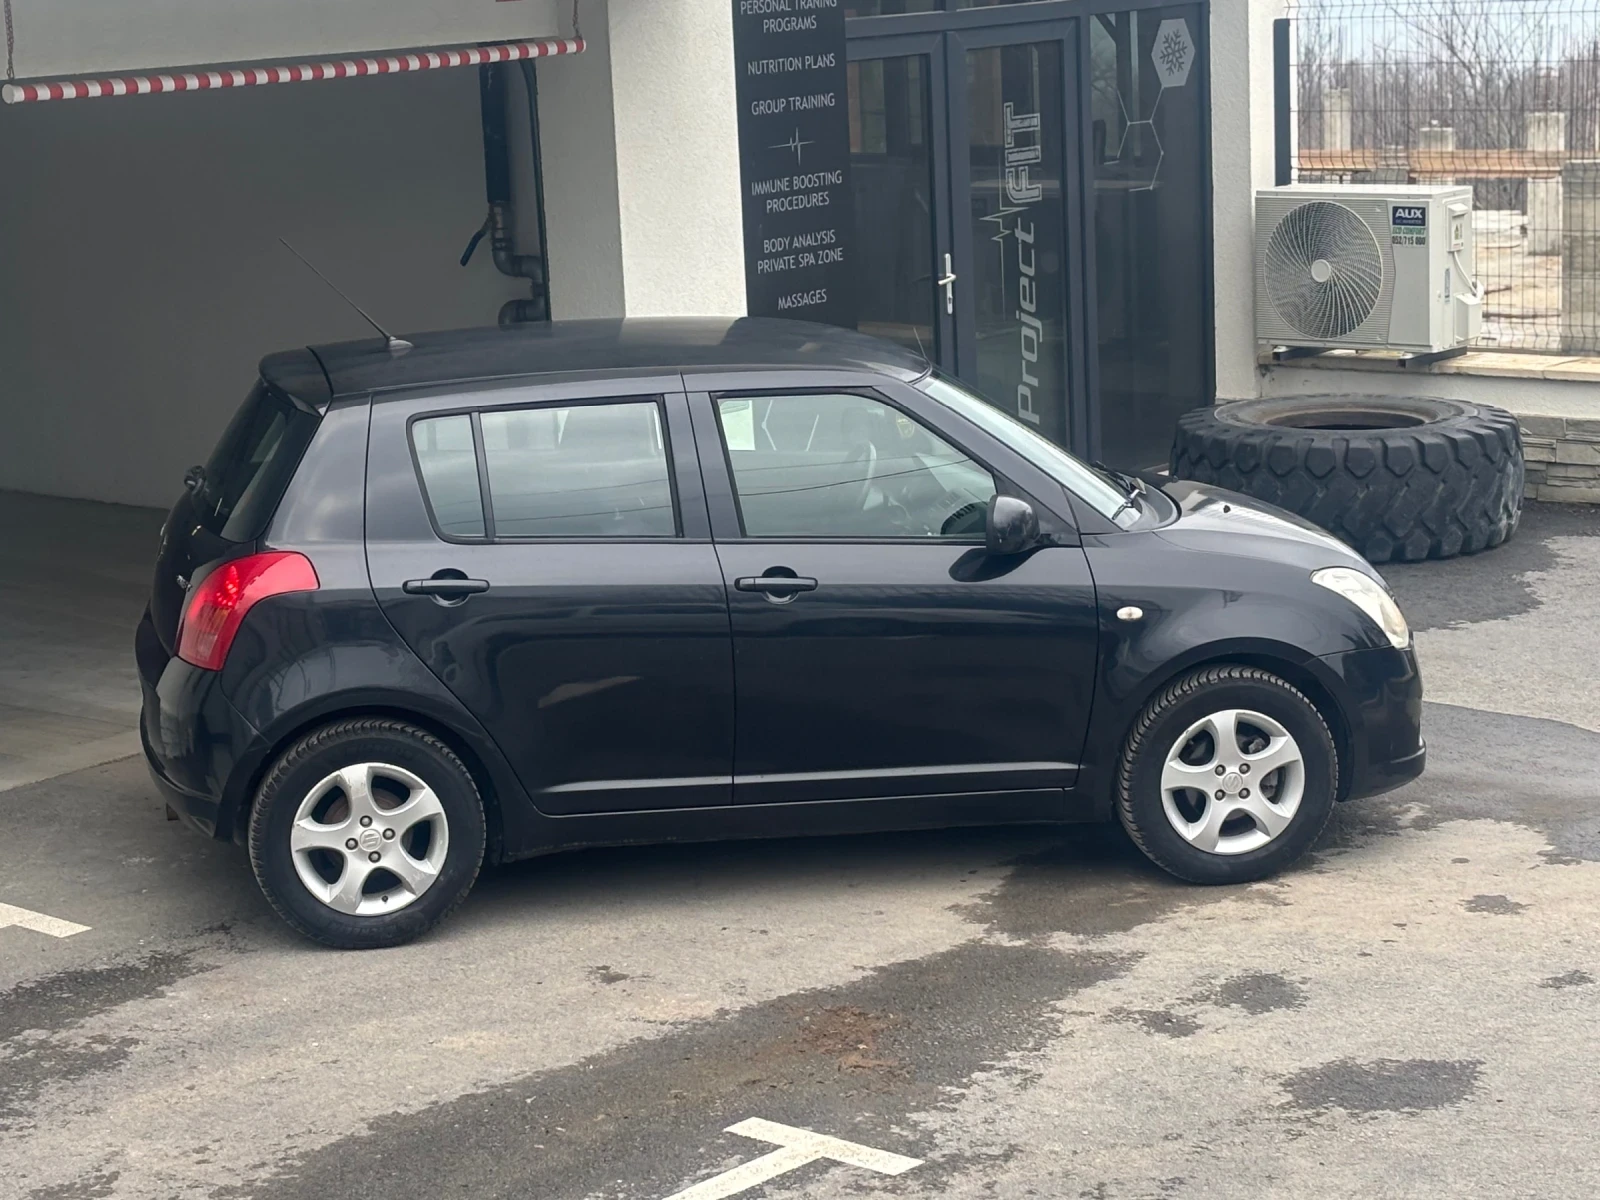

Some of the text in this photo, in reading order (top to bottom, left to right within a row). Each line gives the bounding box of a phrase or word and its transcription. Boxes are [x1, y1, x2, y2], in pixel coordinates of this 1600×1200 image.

[740, 0, 791, 15] PERSONAL
[763, 15, 817, 33] PROGRAMS
[747, 53, 836, 75] NUTRITION PLANS
[751, 93, 835, 116] GROUP TRAINING
[751, 170, 843, 195] IMMUNE BOOSTING
[766, 191, 830, 213] PROCEDURES
[1395, 208, 1423, 218] AUX
[763, 229, 836, 254] BODY ANALYSIS
[757, 247, 844, 274] PRIVATE SPA ZONE
[1004, 102, 1043, 425] Project FIT
[777, 289, 827, 310] MASSAGES
